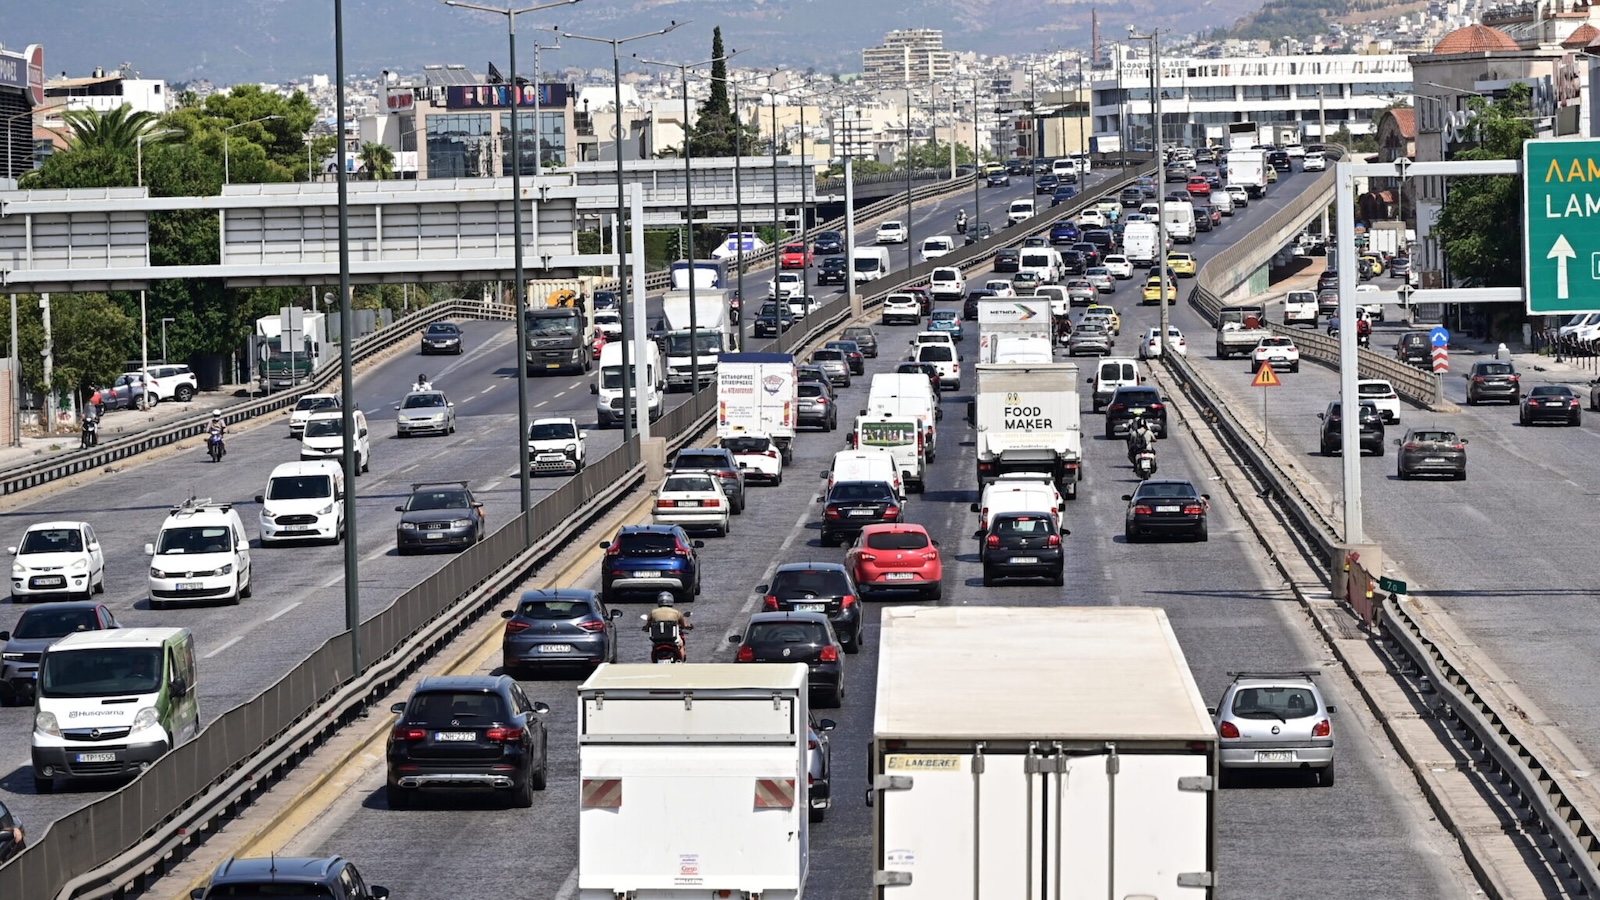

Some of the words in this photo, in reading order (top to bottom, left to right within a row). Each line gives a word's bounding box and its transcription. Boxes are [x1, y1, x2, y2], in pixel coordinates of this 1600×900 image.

[1004, 407, 1041, 417] FOOD
[1005, 419, 1053, 430] MAKER
[905, 759, 957, 767] LAMBERET
